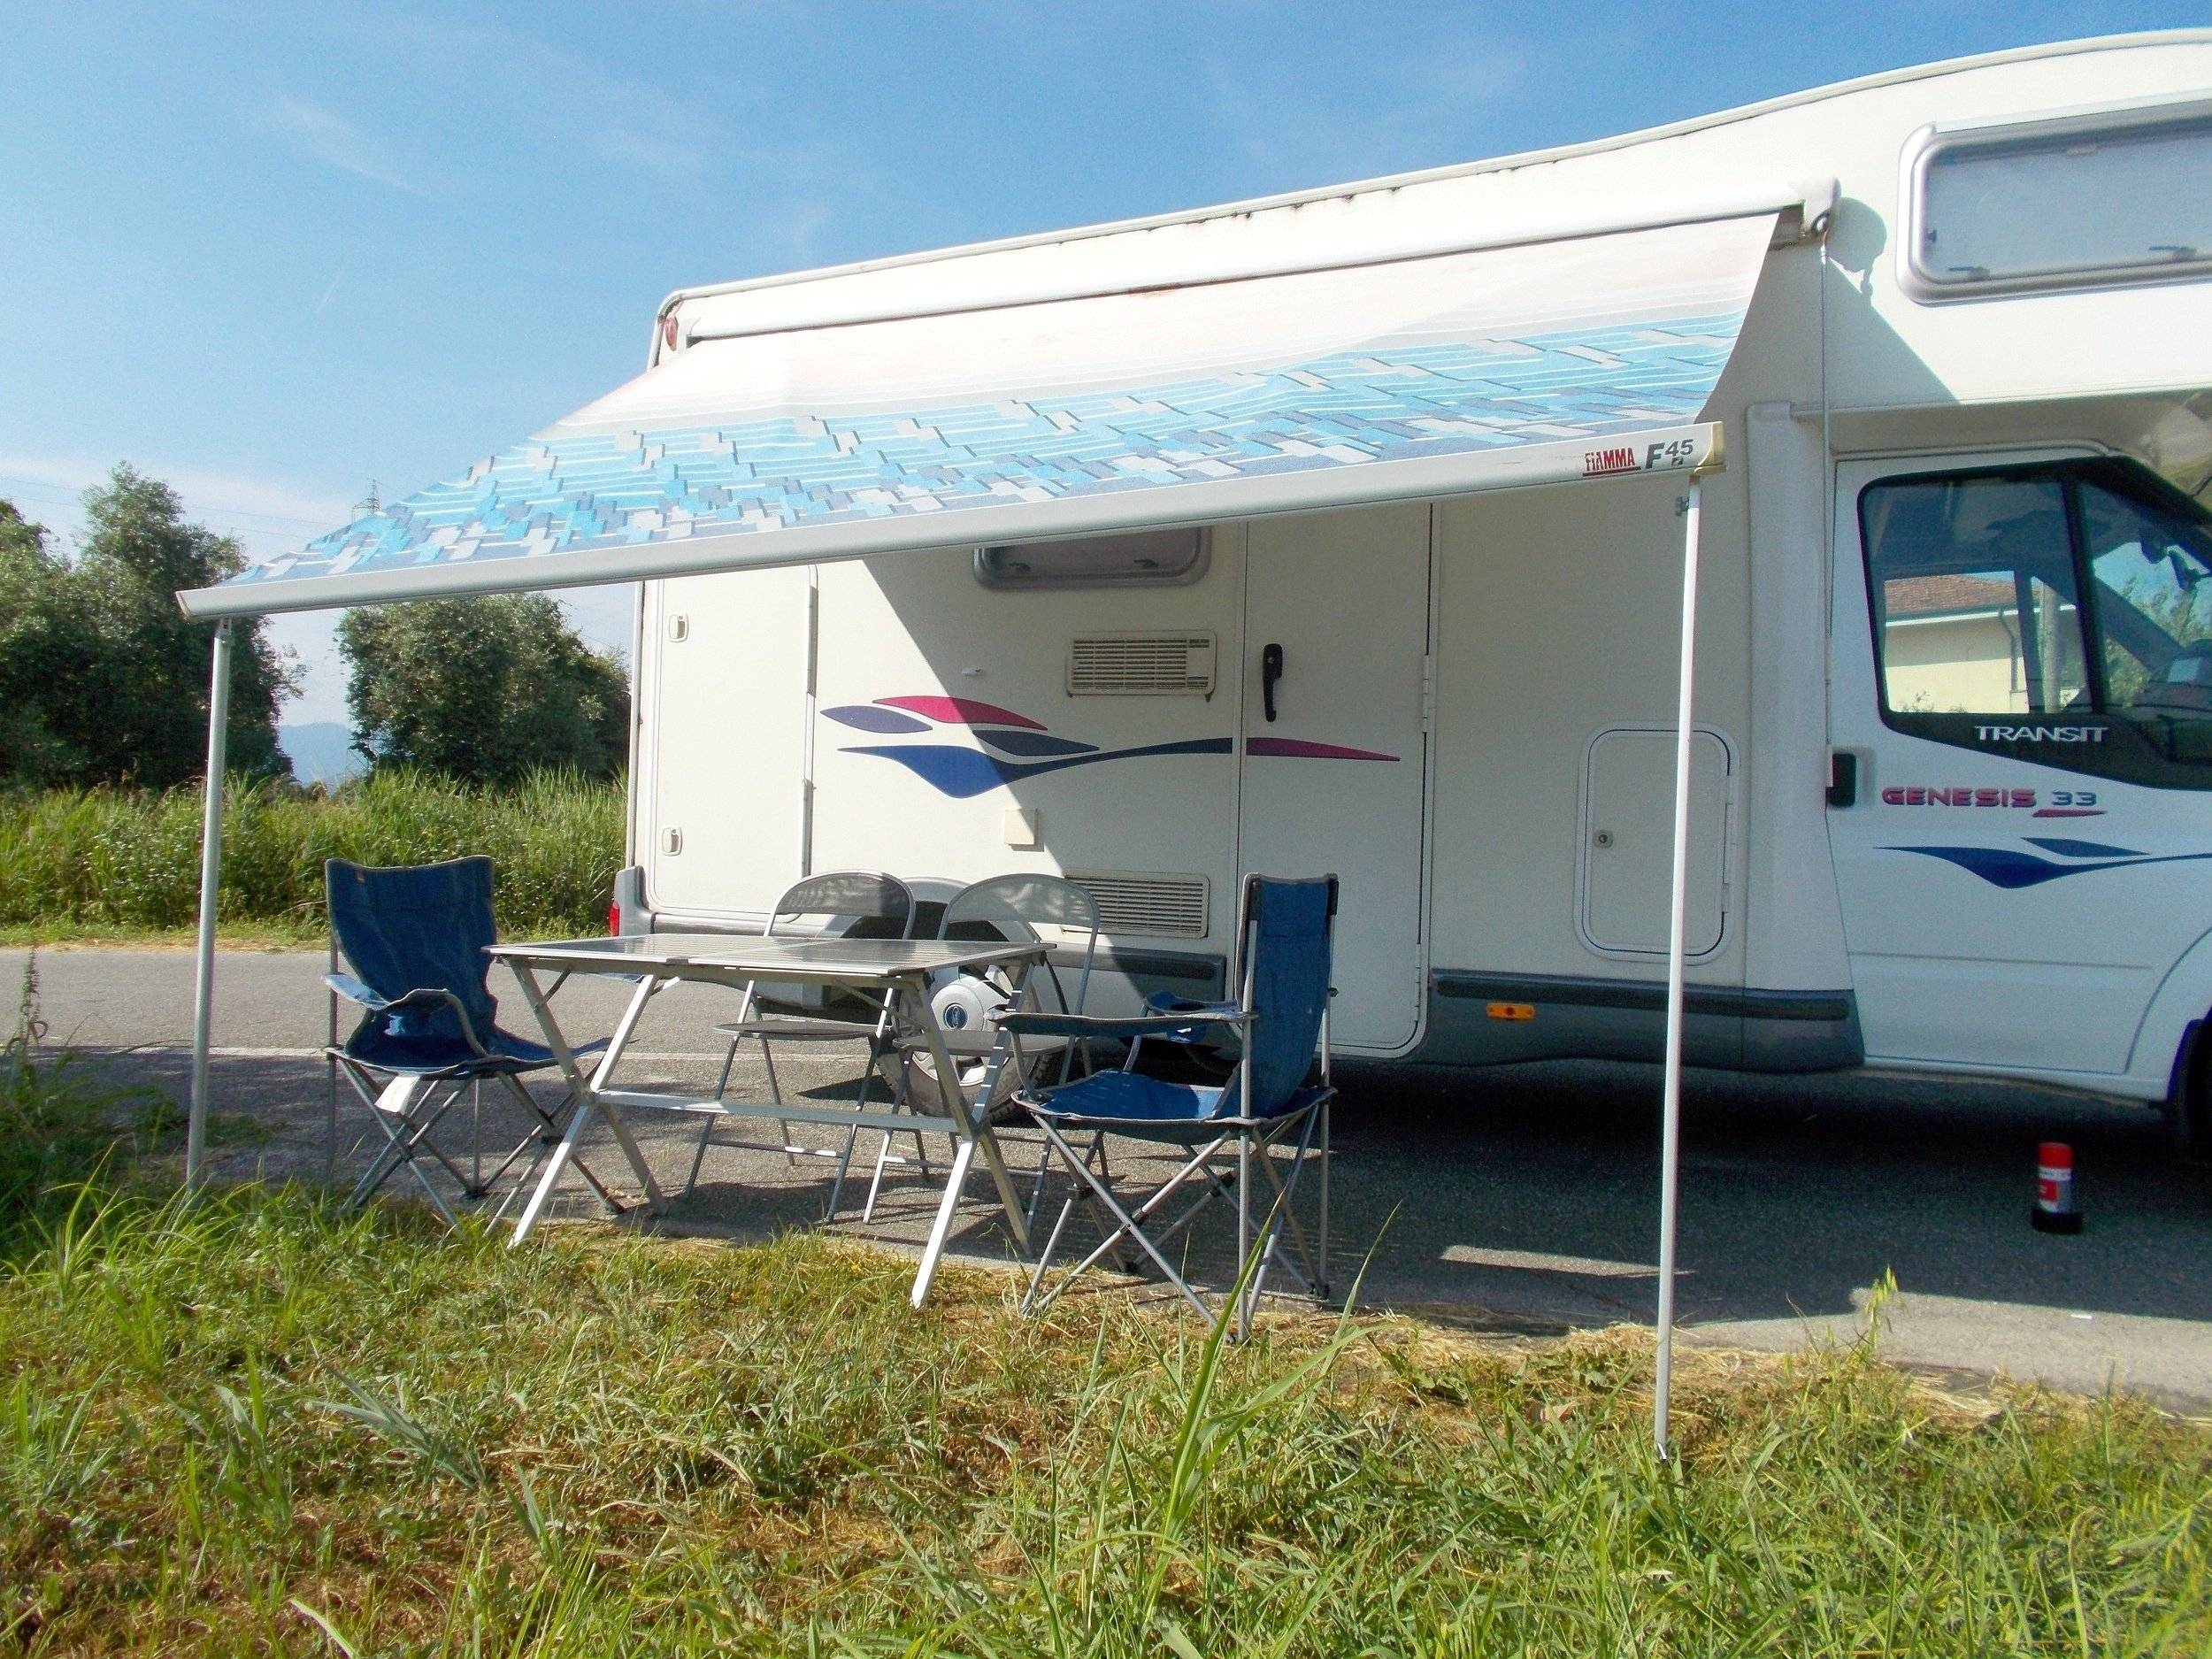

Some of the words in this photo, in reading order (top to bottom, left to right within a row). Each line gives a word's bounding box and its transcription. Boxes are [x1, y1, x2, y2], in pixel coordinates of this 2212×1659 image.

[1974, 726, 2108, 742] TRANSIT
[1881, 786, 2036, 807] GENESIS
[2052, 790, 2097, 806] 33
